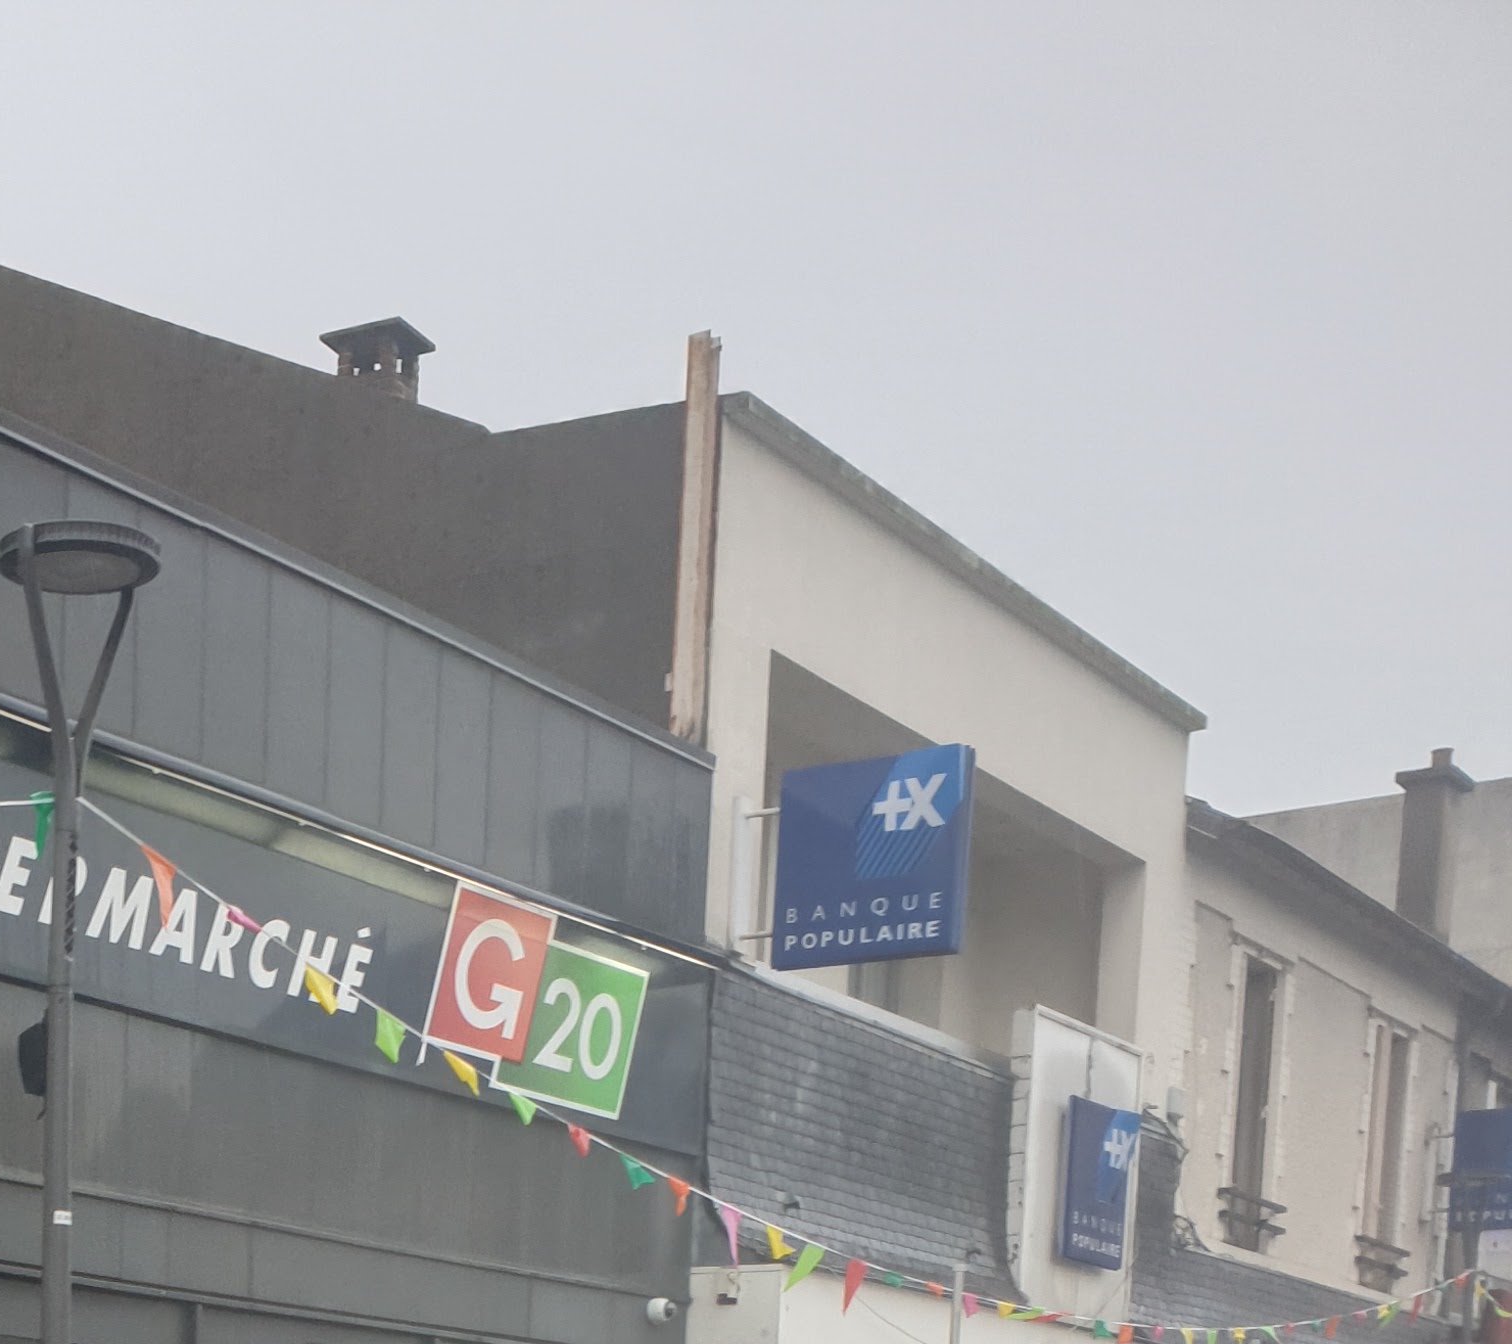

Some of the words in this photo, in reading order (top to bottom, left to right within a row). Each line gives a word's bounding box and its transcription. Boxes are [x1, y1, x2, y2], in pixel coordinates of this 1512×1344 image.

[785, 891, 943, 924] BANQUE
[784, 920, 942, 951] POPULAIRE
[454, 918, 623, 1080] G20
